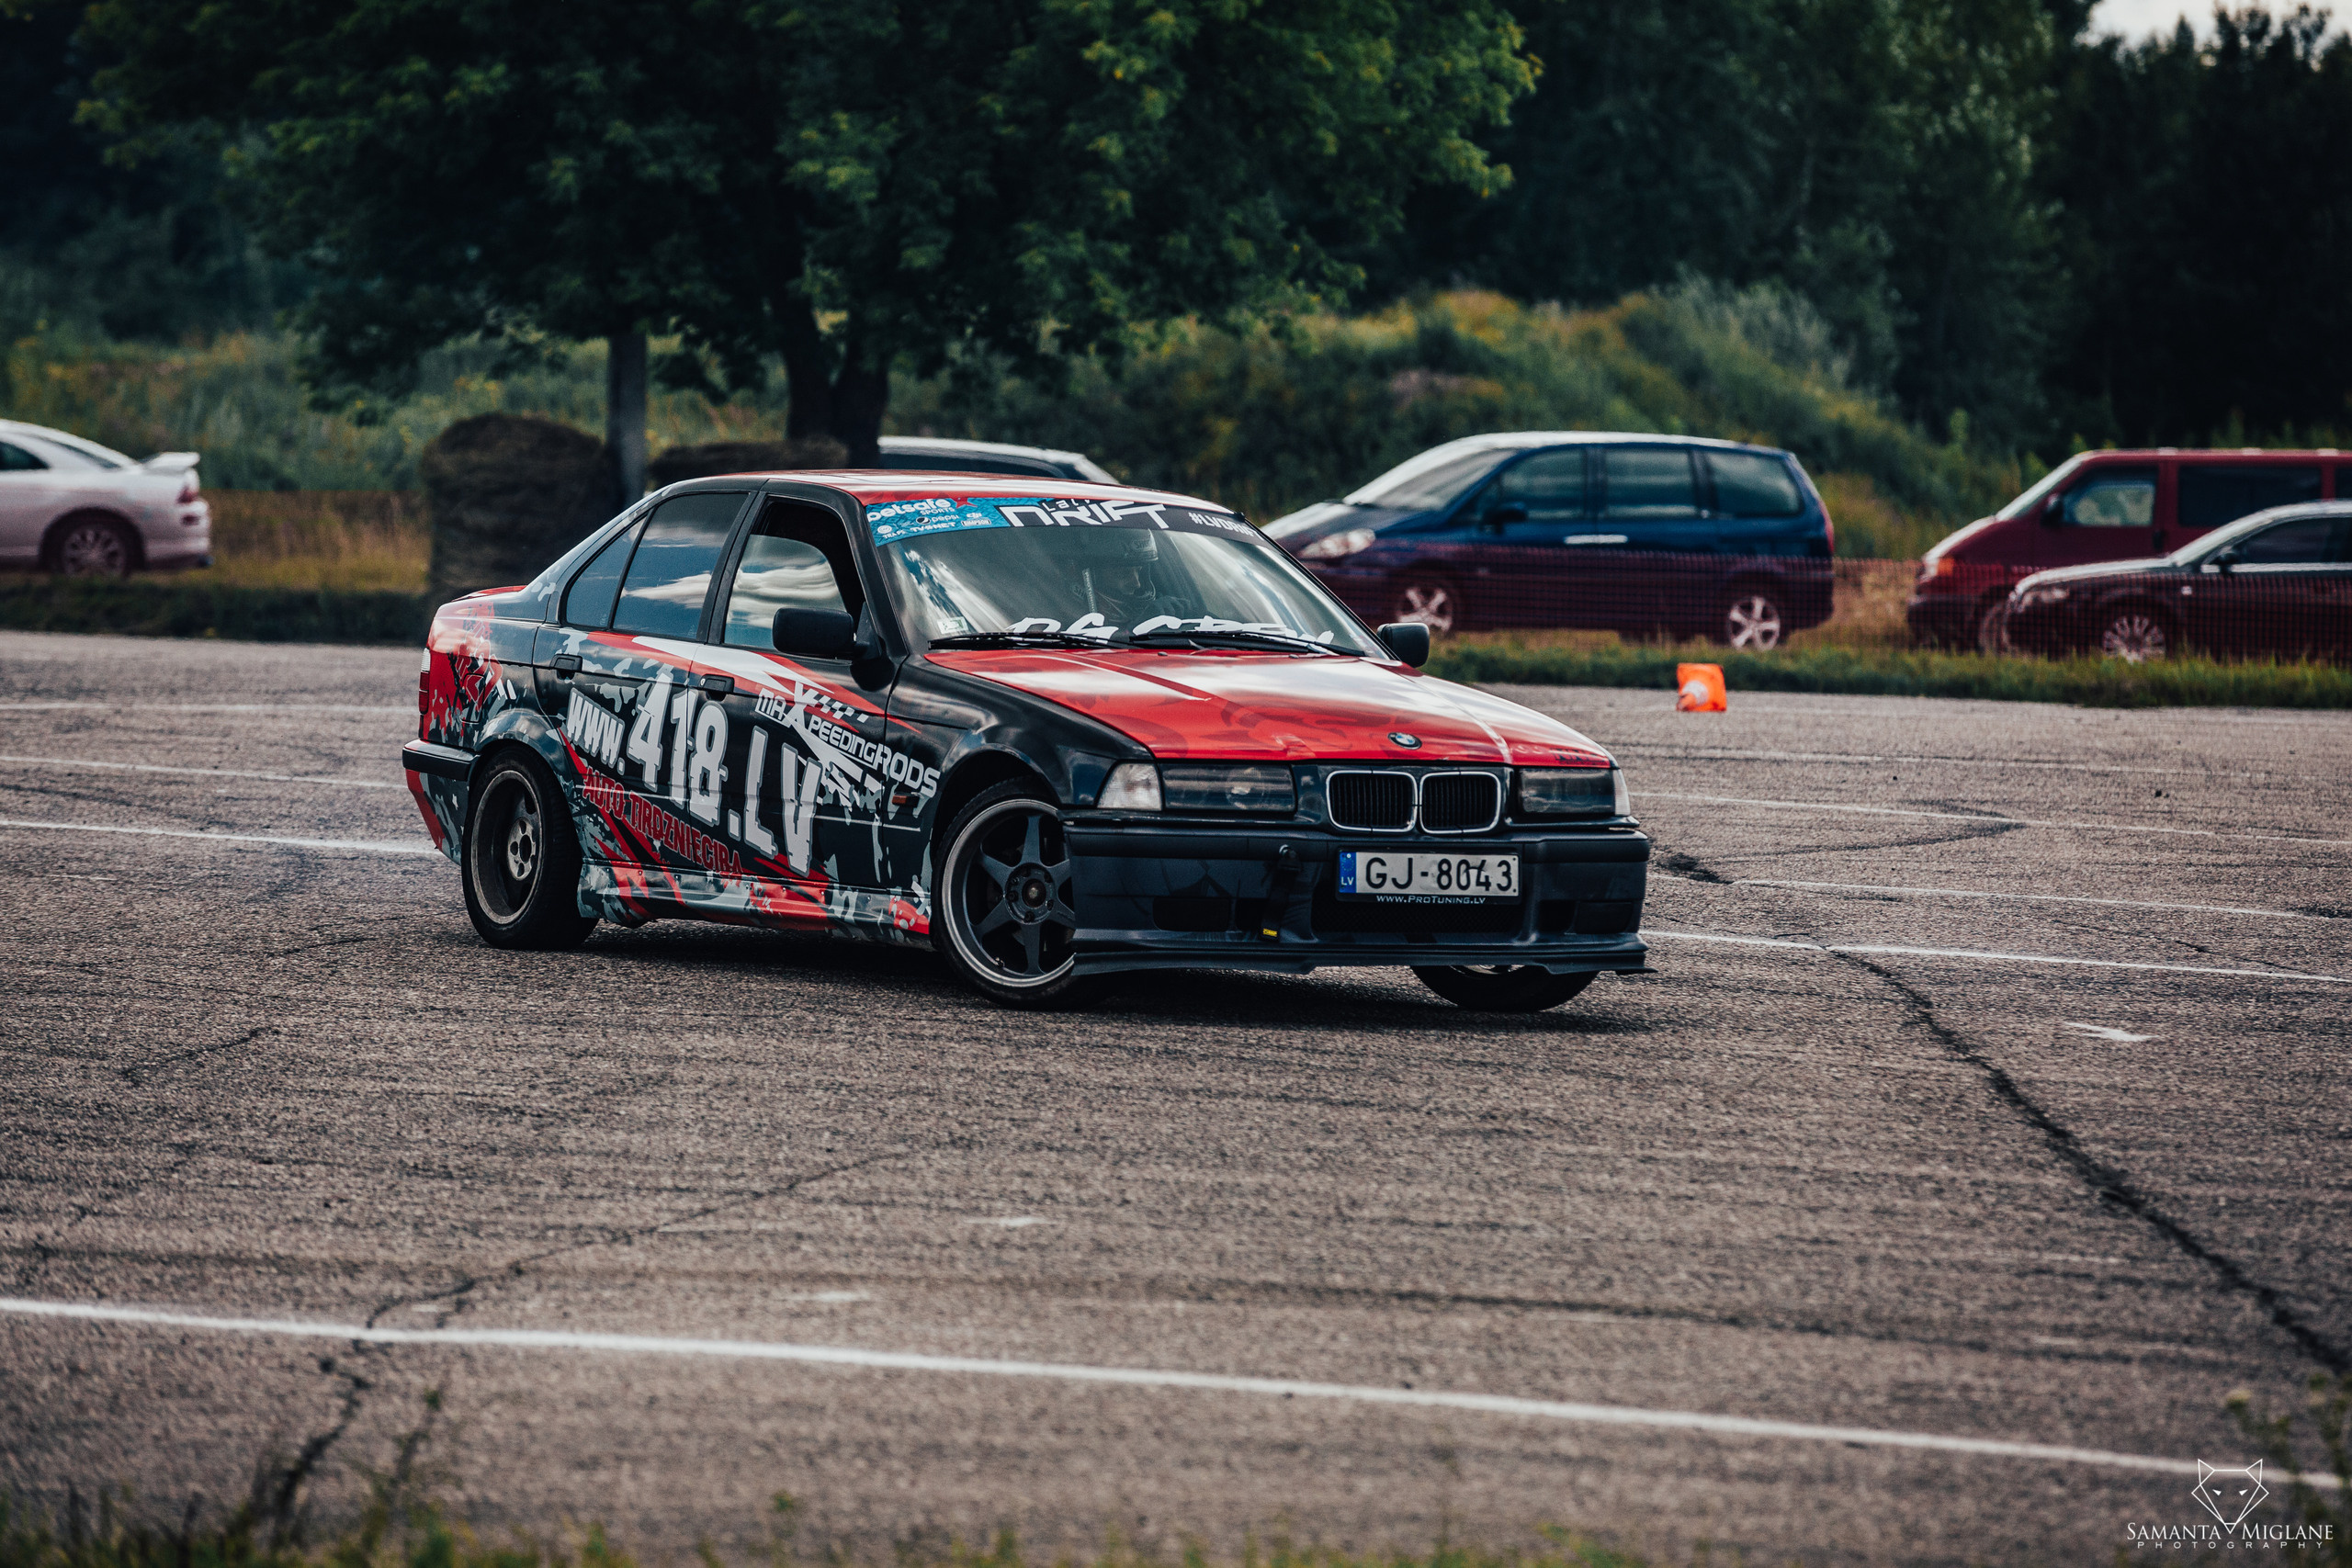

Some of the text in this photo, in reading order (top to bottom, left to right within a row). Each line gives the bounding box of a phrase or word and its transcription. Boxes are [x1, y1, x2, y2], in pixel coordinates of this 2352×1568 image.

[920, 507, 956, 515] SPORTS
[931, 514, 959, 523] pepsi
[999, 500, 1169, 529] DRIFT
[1340, 857, 1512, 892] LV GJ-8043
